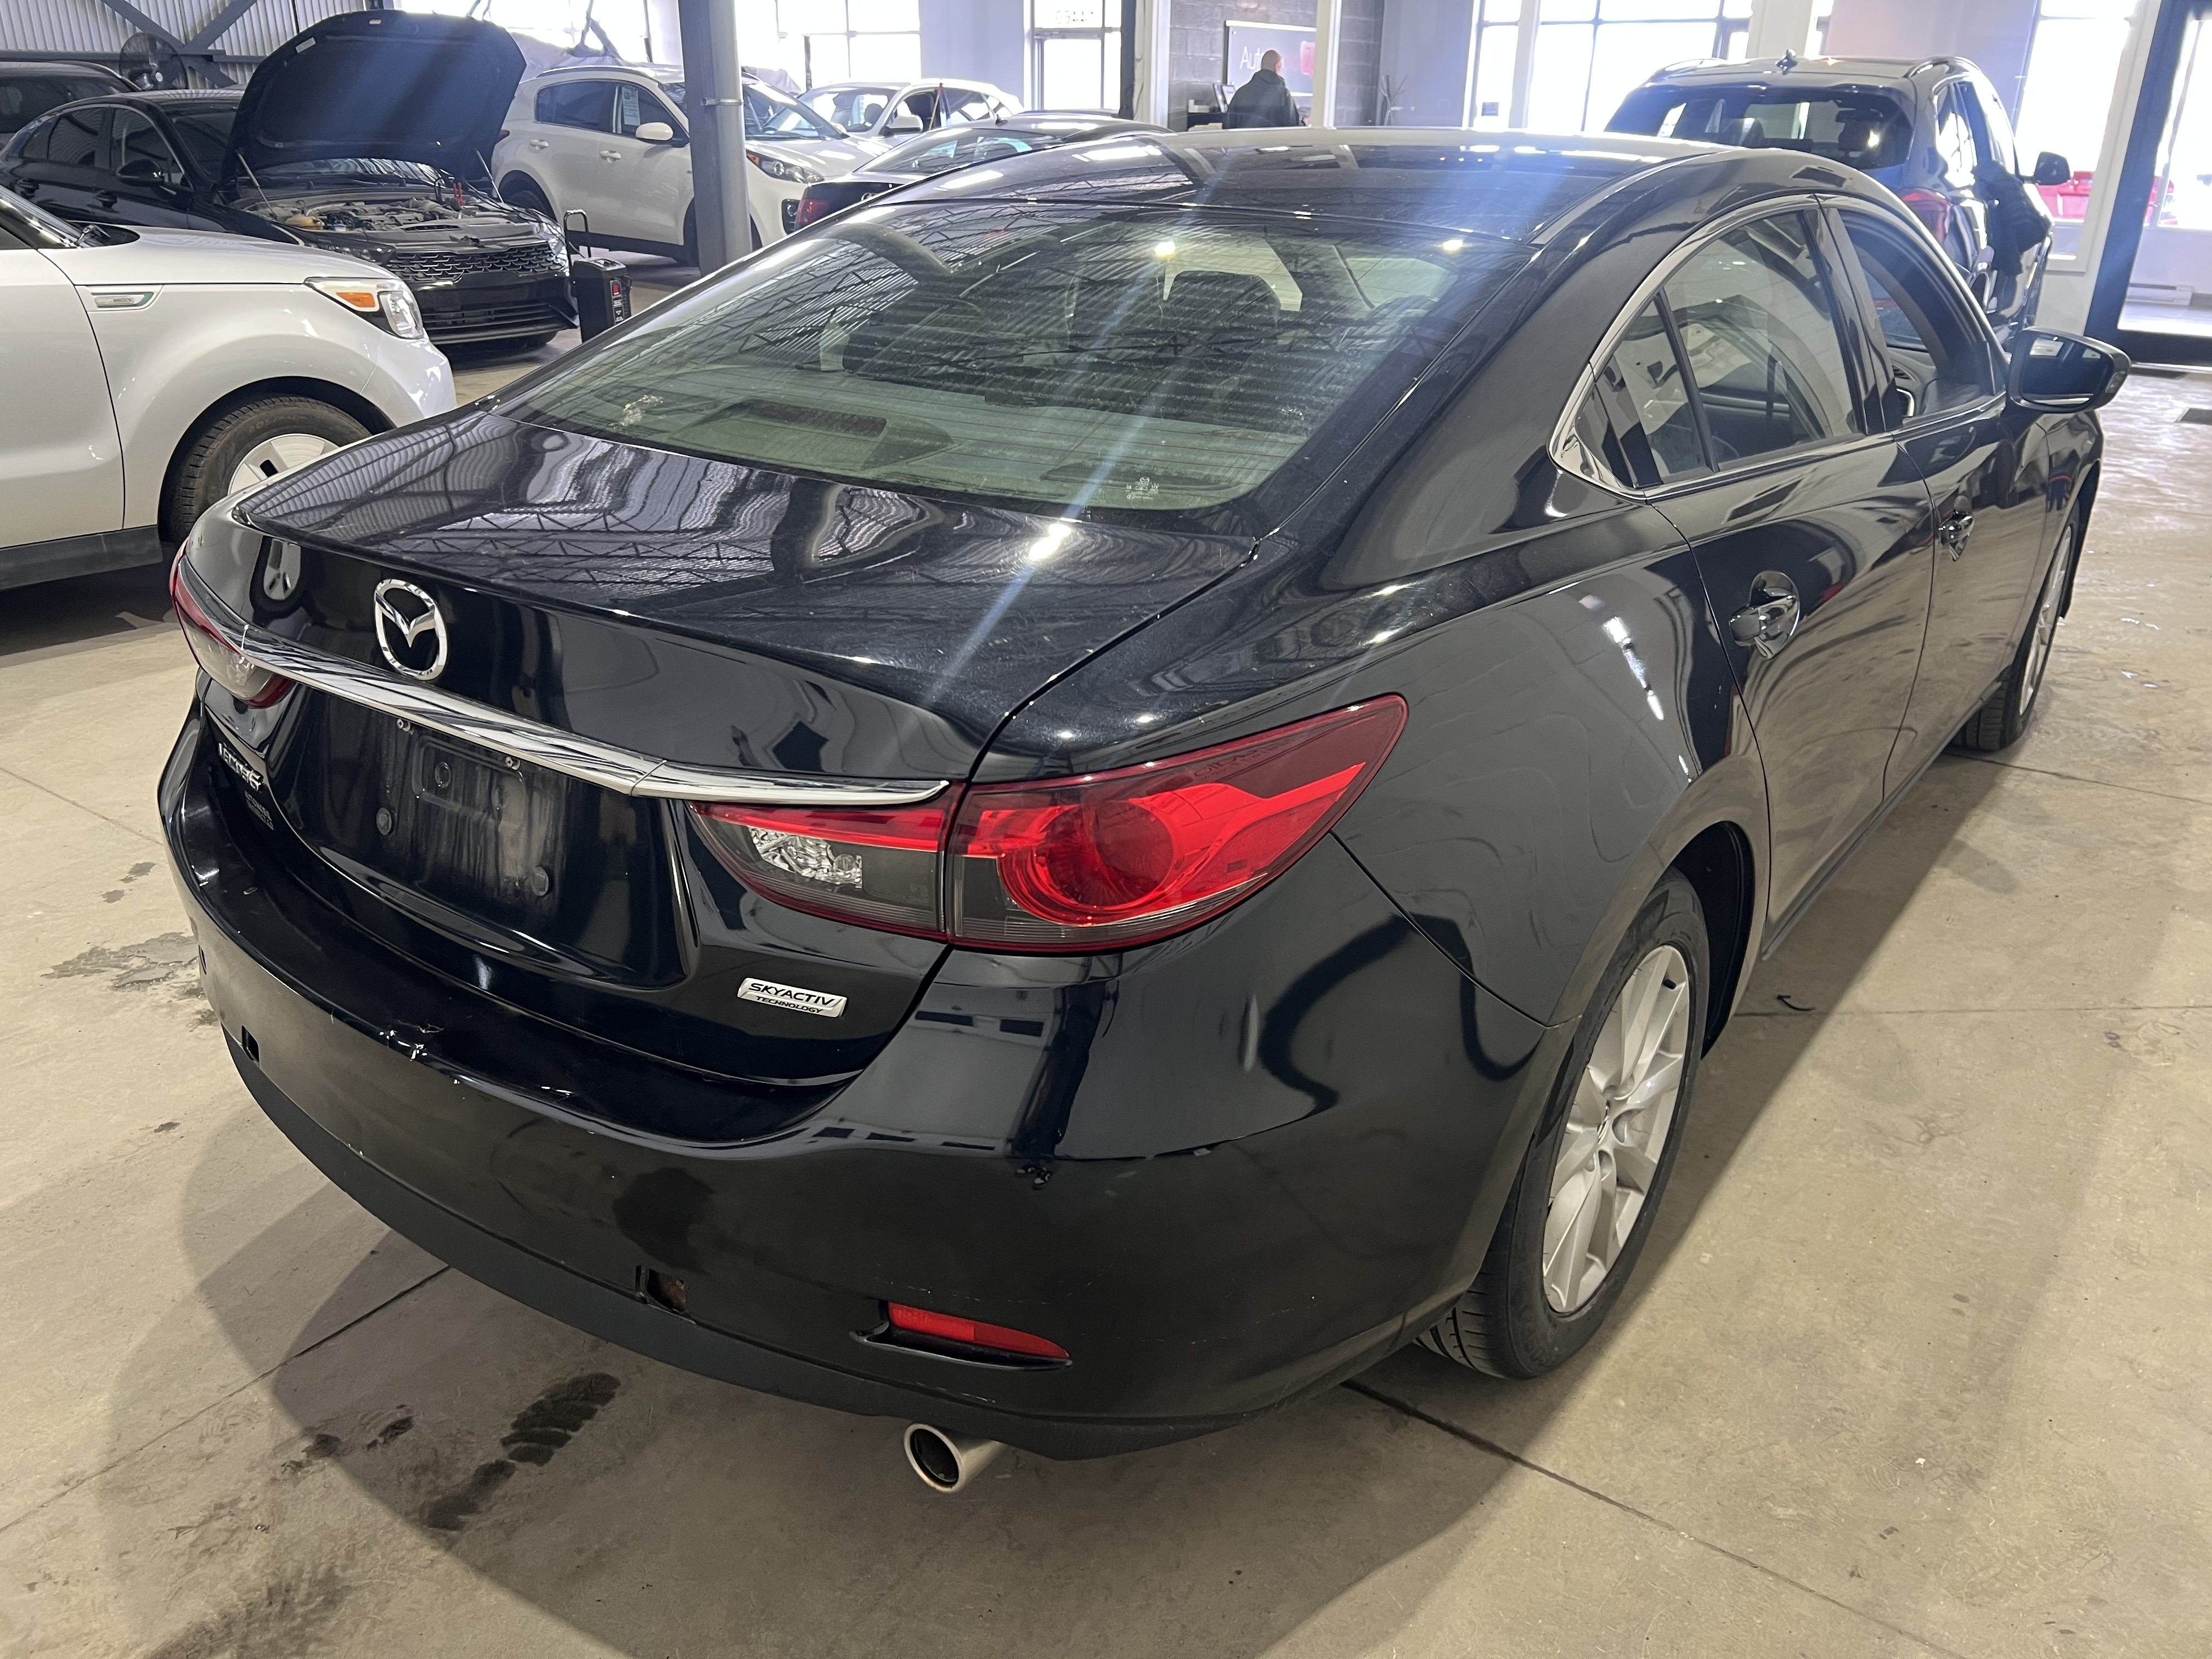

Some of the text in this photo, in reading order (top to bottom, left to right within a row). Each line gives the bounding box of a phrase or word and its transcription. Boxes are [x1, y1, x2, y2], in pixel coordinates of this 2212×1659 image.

[1239, 46, 1263, 70] Aut
[748, 983, 834, 1006] SKYACTIV
[755, 996, 823, 1013] TECHNOLOGY
